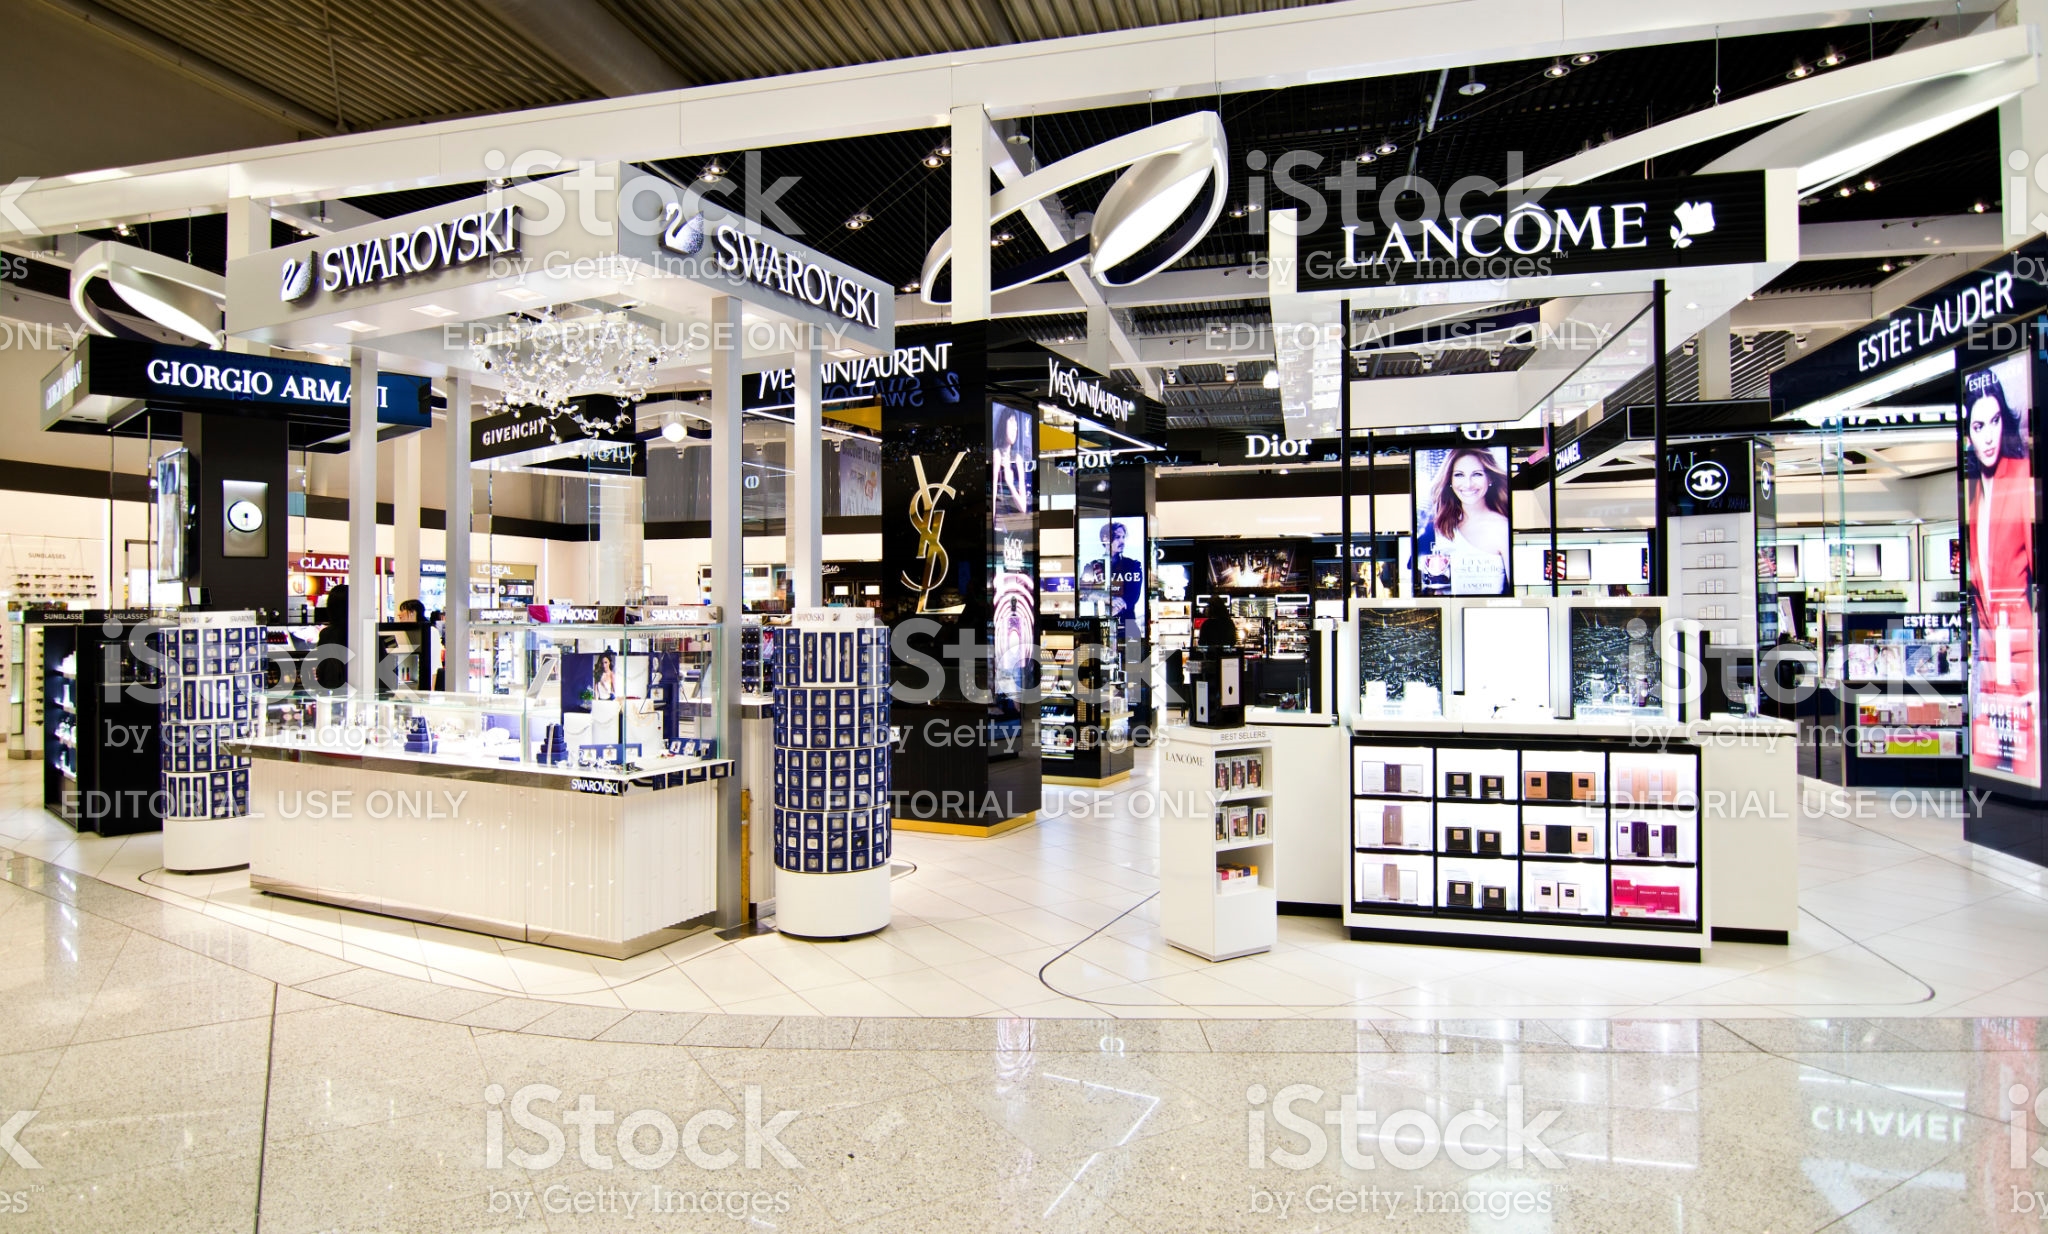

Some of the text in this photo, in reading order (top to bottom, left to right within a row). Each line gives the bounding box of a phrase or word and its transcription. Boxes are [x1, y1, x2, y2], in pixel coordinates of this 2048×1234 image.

[322, 204, 520, 293] SWAROVSKI
[1341, 202, 1649, 269] LANCÔME
[713, 224, 881, 330] SWAROVSKI
[1918, 271, 2014, 347] LAUDER
[147, 359, 273, 397] GIORGIO
[280, 376, 389, 410] ARMAI
[482, 417, 547, 447] GIVENCHY
[1245, 434, 1312, 458] Dior
[1555, 442, 1581, 471] CHANEL
[551, 608, 599, 621] SWAROVSKI
[650, 608, 699, 621] SWAROVSKI
[1981, 702, 2028, 720] MODERN
[1220, 730, 1266, 741] BEST SELLERS
[1989, 718, 2020, 733] MUSE
[571, 779, 619, 794] SWAROVSKI
